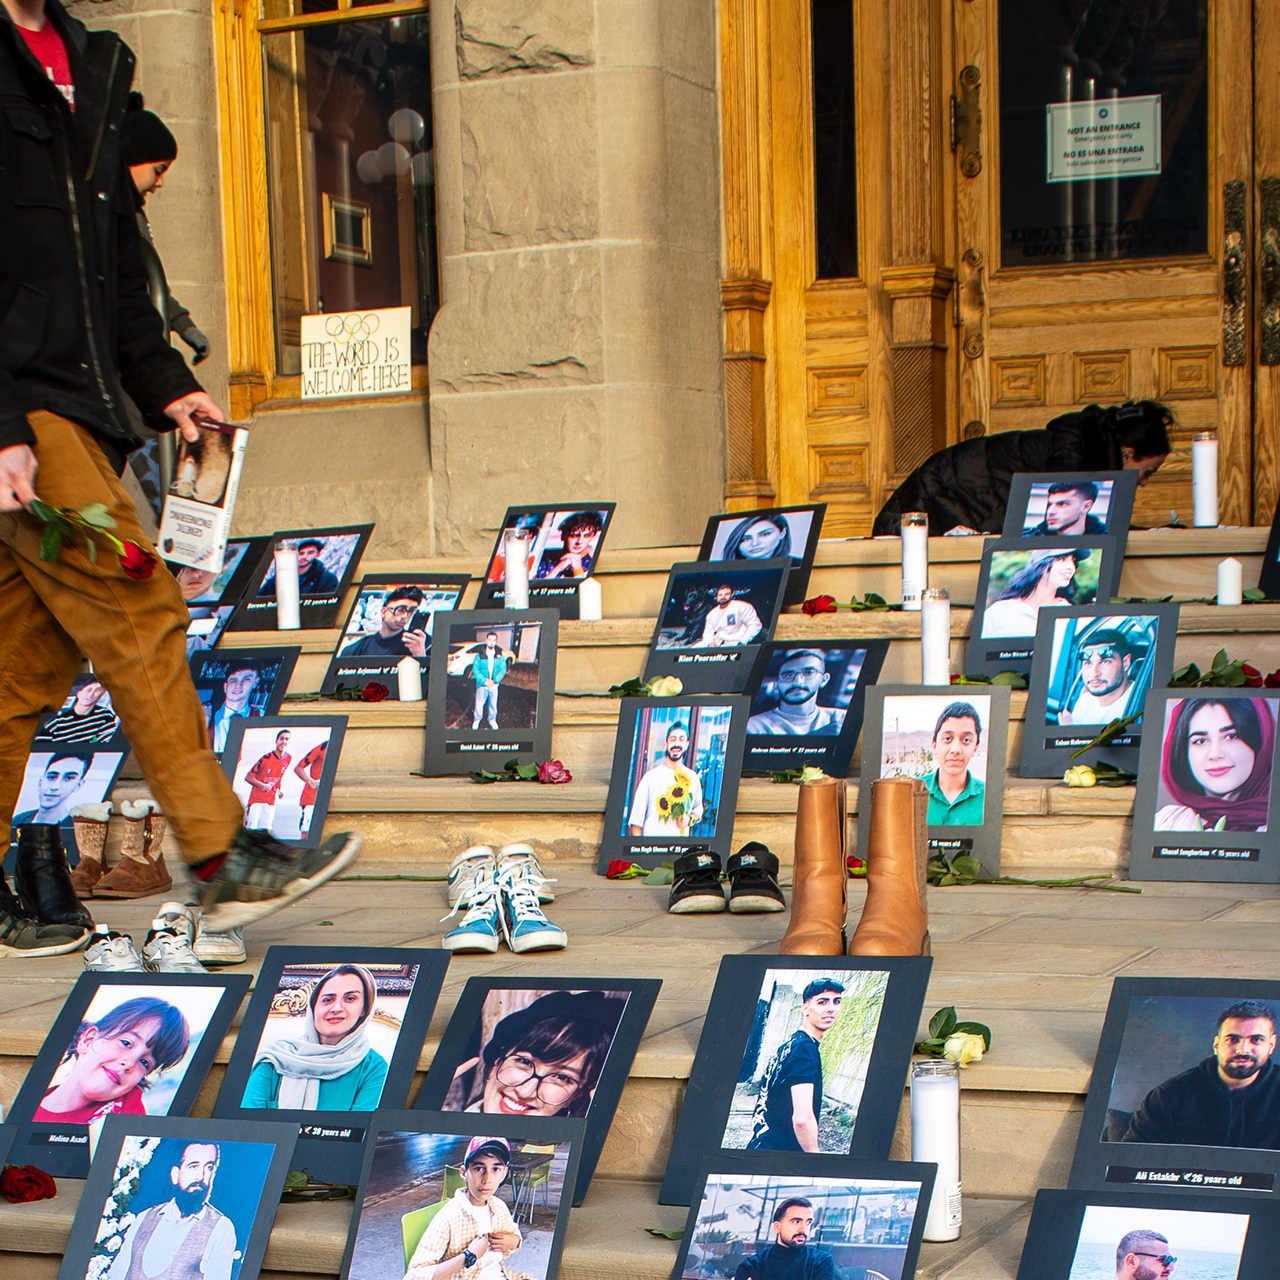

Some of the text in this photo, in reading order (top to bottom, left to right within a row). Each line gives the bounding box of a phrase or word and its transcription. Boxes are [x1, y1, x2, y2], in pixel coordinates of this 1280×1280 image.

[1067, 122, 1141, 135] NOT AN ENTRANCE
[1064, 145, 1144, 158] NO ES UNA ENTRADA
[302, 342, 332, 368] THE
[385, 336, 400, 363] IS
[302, 364, 408, 395] WELCOME HERE
[321, 1129, 351, 1137] years old
[1135, 1172, 1242, 1185] Ali Estakhr 26 years old
